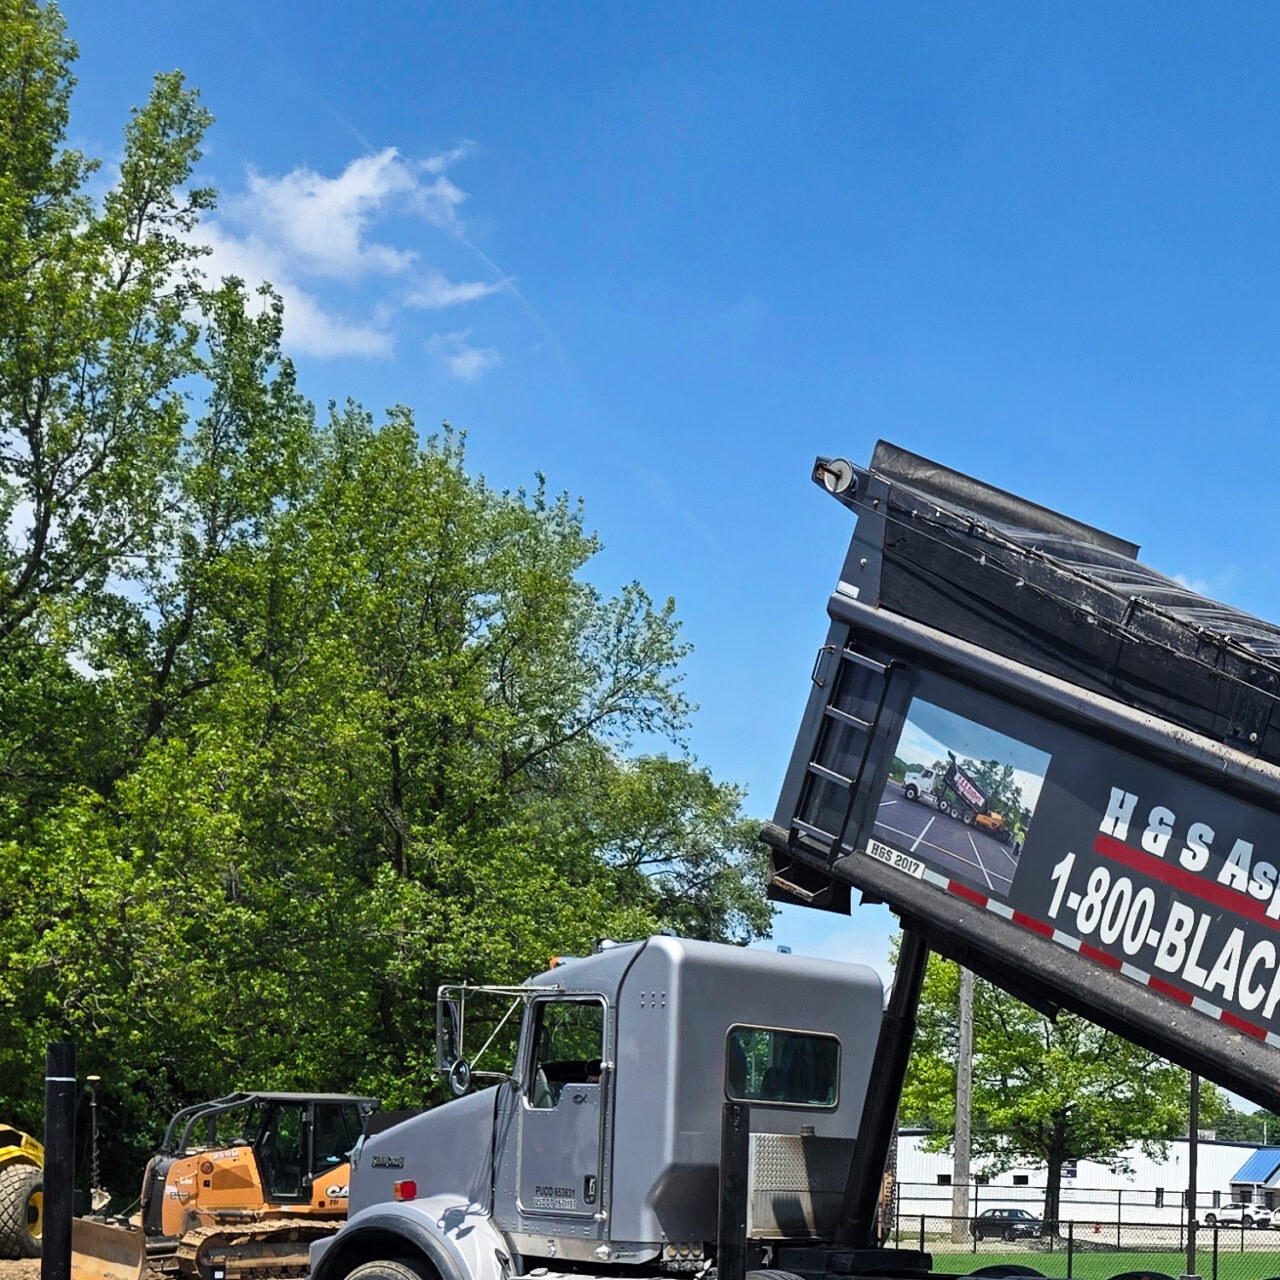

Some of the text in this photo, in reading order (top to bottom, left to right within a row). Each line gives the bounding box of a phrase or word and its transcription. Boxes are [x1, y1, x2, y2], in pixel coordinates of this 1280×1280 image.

[1099, 787, 1138, 841] H
[1141, 806, 1176, 857] &
[1179, 823, 1215, 872] S
[894, 855, 920, 874] 2017
[536, 1185, 553, 1197] PUCO
